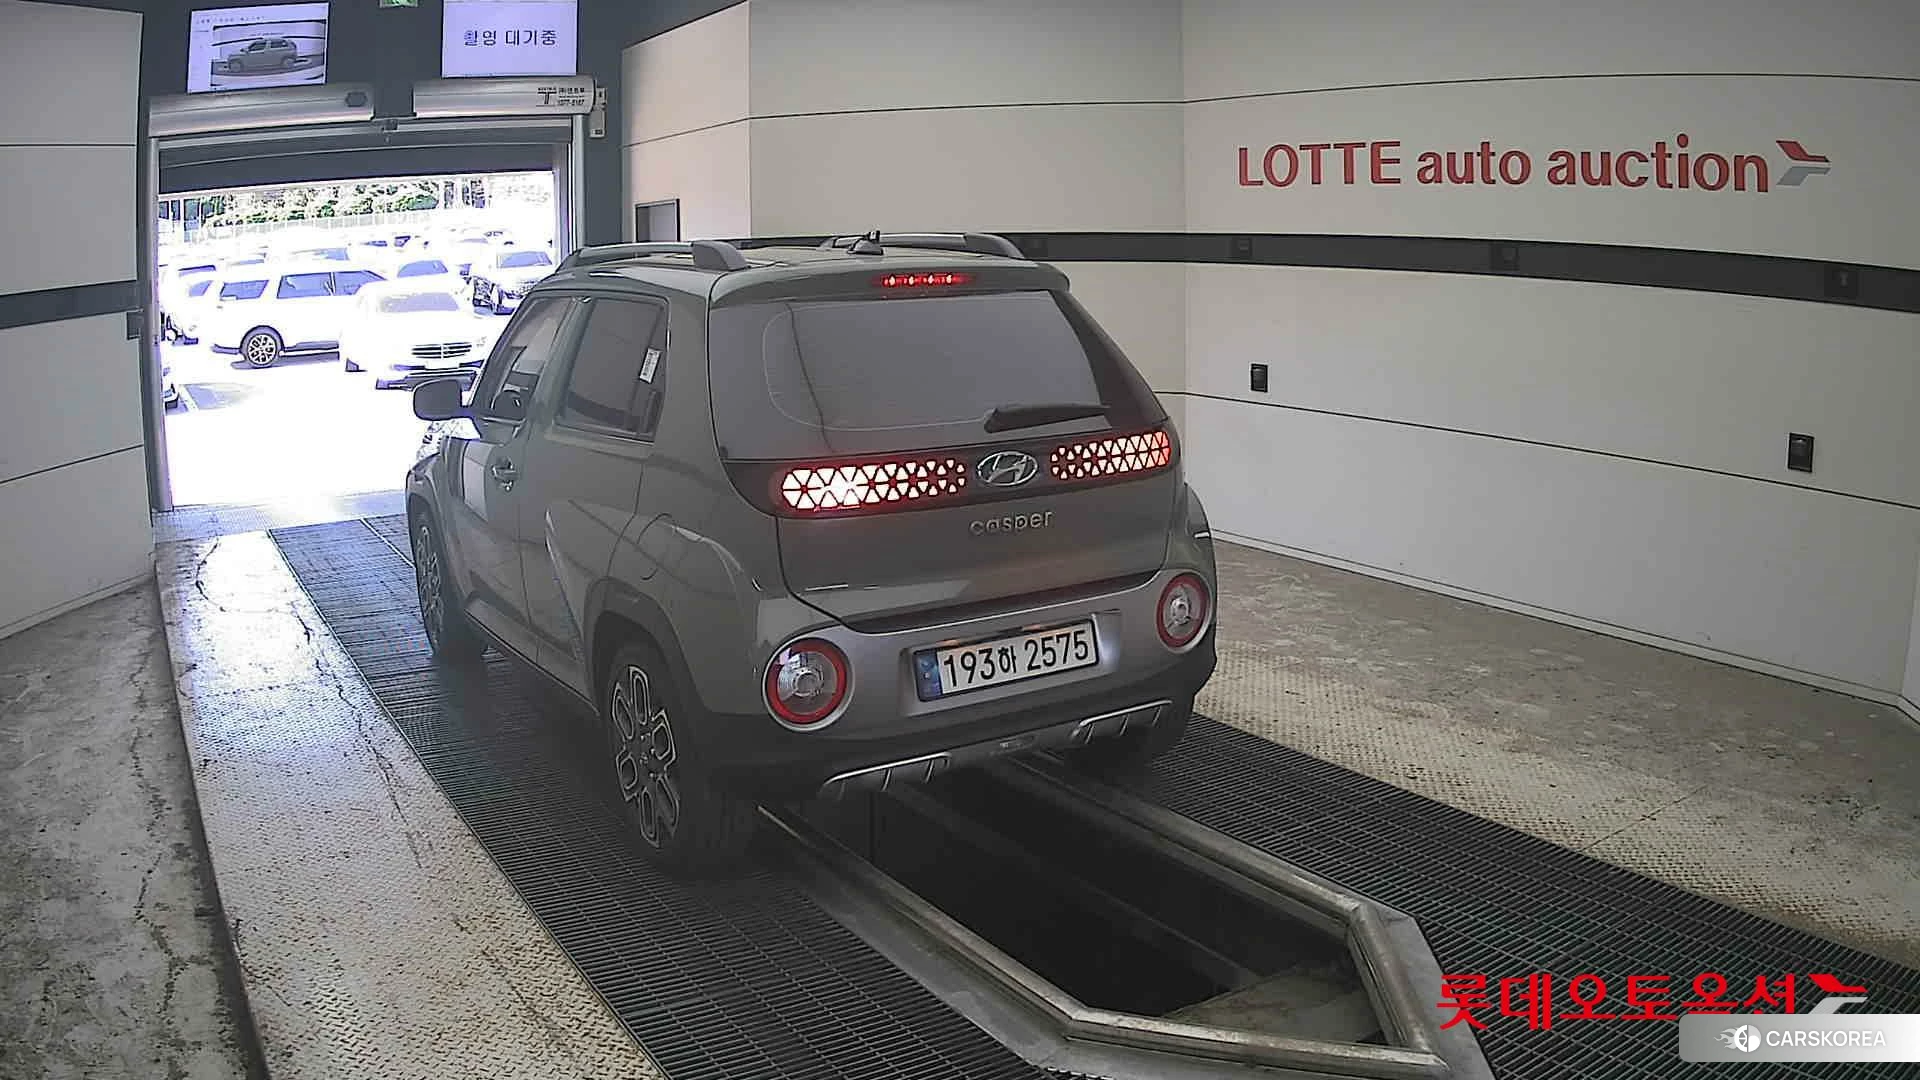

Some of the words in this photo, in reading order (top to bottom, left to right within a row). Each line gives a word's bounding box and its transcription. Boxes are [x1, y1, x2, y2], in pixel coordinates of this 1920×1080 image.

[505, 29, 557, 47] 대기중
[1239, 141, 1400, 187] LOTTE
[1417, 142, 1531, 184] auto
[1547, 134, 1768, 193] auction
[969, 511, 1054, 536] casper
[944, 645, 1017, 688] 193하
[1024, 630, 1089, 671] 2575
